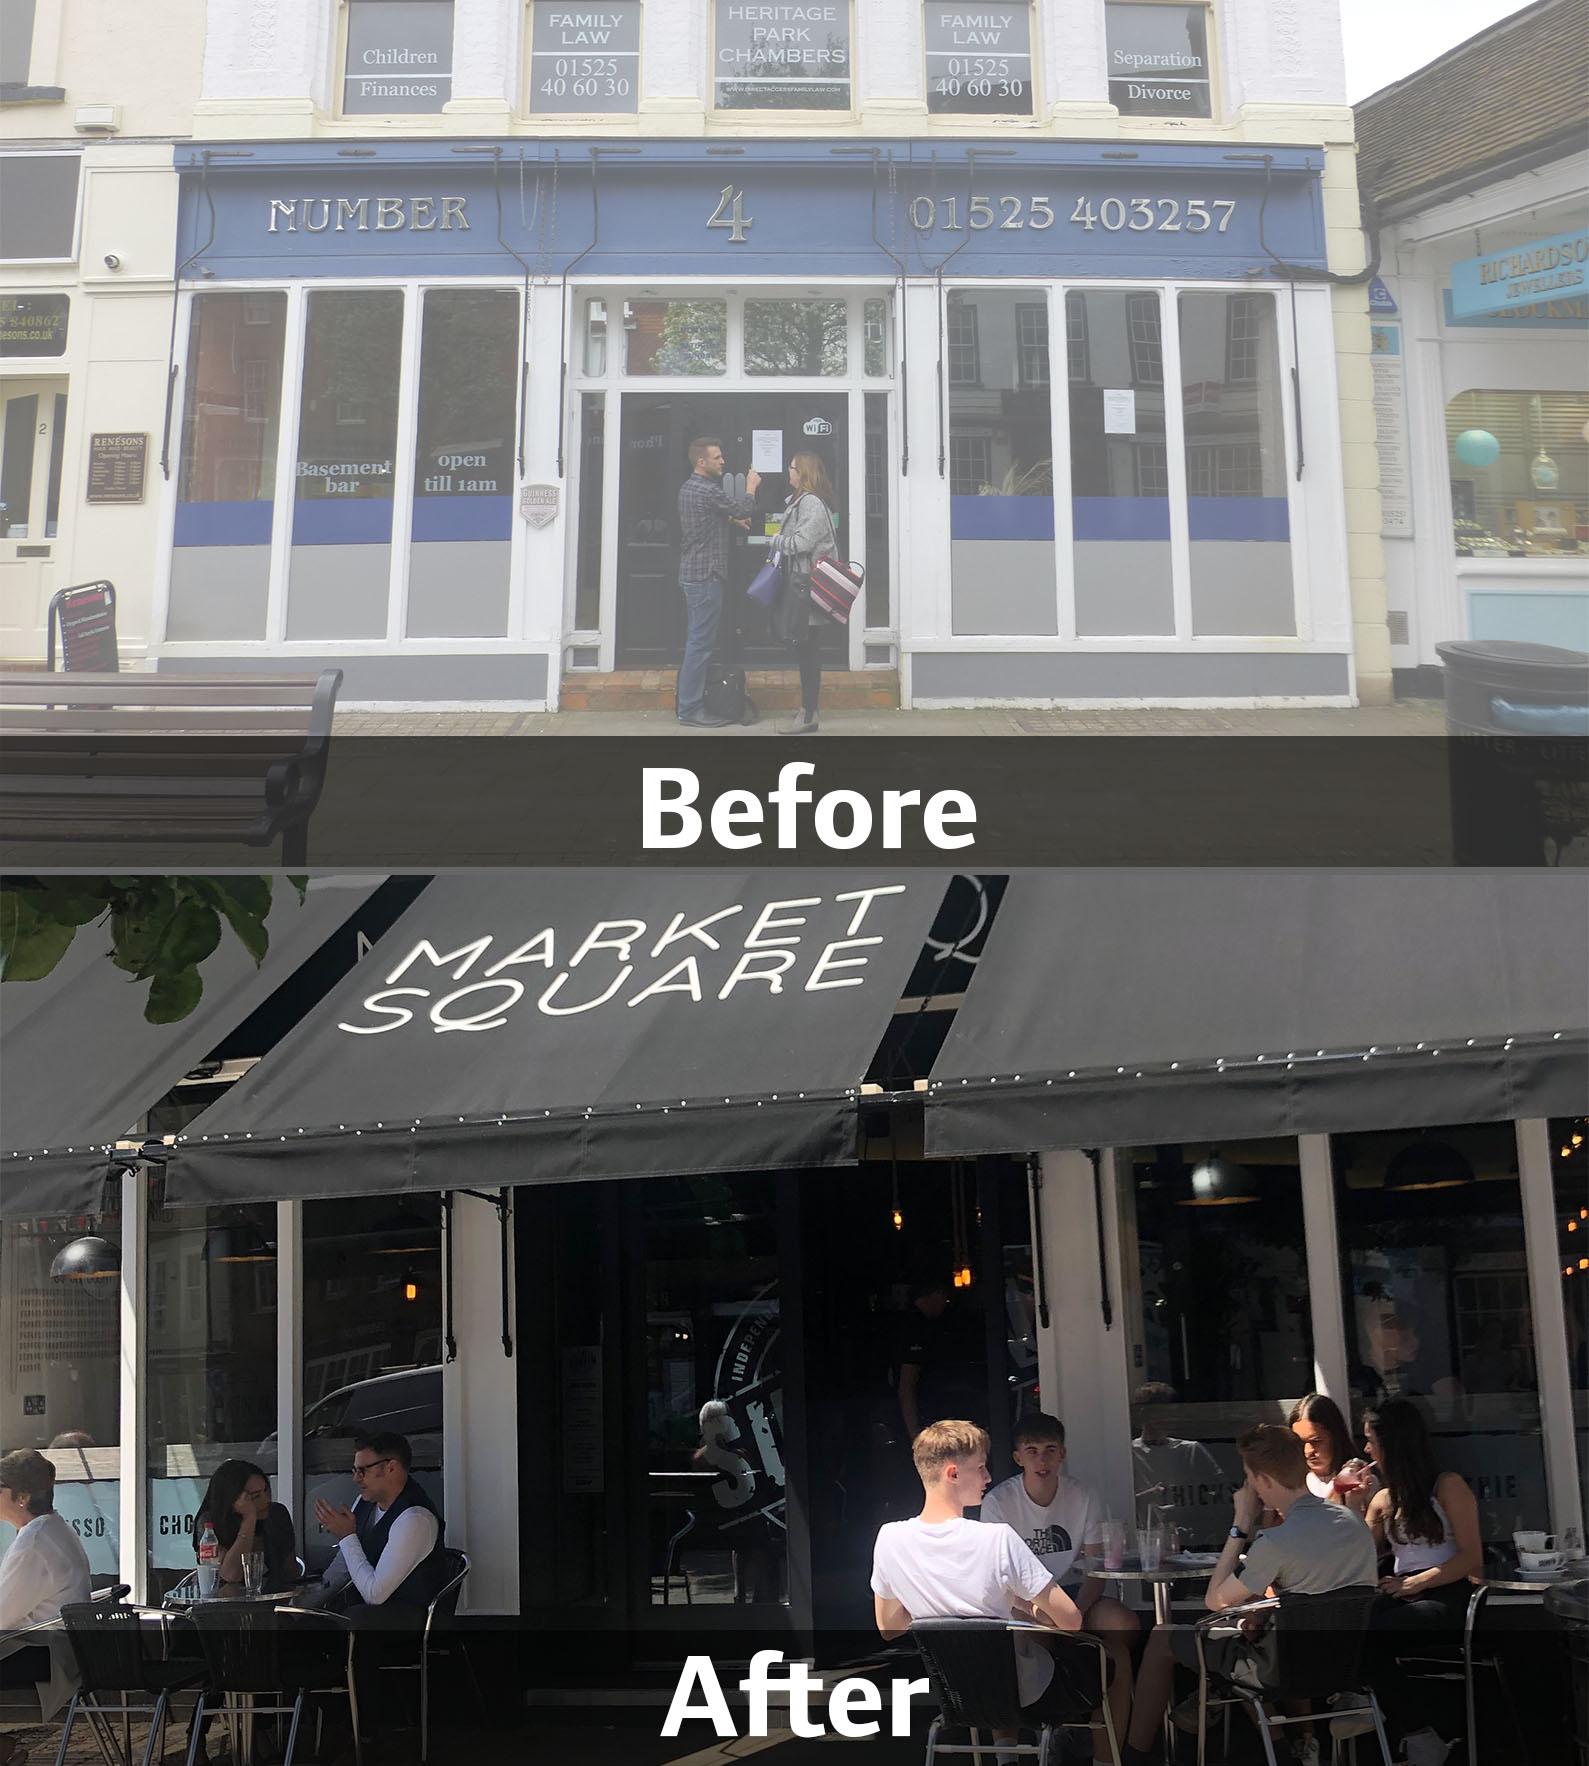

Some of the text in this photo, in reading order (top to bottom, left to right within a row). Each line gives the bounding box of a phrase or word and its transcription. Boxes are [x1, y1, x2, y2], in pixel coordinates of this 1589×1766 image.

[548, 13, 624, 28] FAMILY
[727, 5, 837, 22] HERITAGE
[940, 14, 1013, 29] FAMILY
[561, 30, 611, 44] LAW
[753, 26, 812, 42] PARK
[952, 30, 1001, 45] LAW
[362, 47, 439, 66] Children
[718, 47, 847, 65] CHAMBERS
[1113, 49, 1203, 69] Separation
[555, 58, 618, 77] 01525
[947, 58, 1010, 77] 01525
[359, 79, 438, 98] Finances
[540, 78, 630, 97] 40 60 30
[935, 78, 1023, 97] 40 60 30
[1127, 83, 1192, 101] Divorce
[266, 184, 1237, 243] NUMBER 4 01525 403257
[1479, 238, 1589, 285] RICHARDSO
[1505, 269, 1585, 299] JEWELLERS
[0, 328, 54, 341] esons.co.uk
[38, 422, 48, 435] 2
[296, 460, 393, 477] Basement
[438, 454, 487, 470] open
[325, 477, 360, 493] bar
[424, 475, 498, 492] till 1am
[522, 488, 557, 498] GUINNESS
[385, 884, 907, 986] MARKET
[337, 936, 885, 1034] SQUARE
[66, 1516, 105, 1539] SSO
